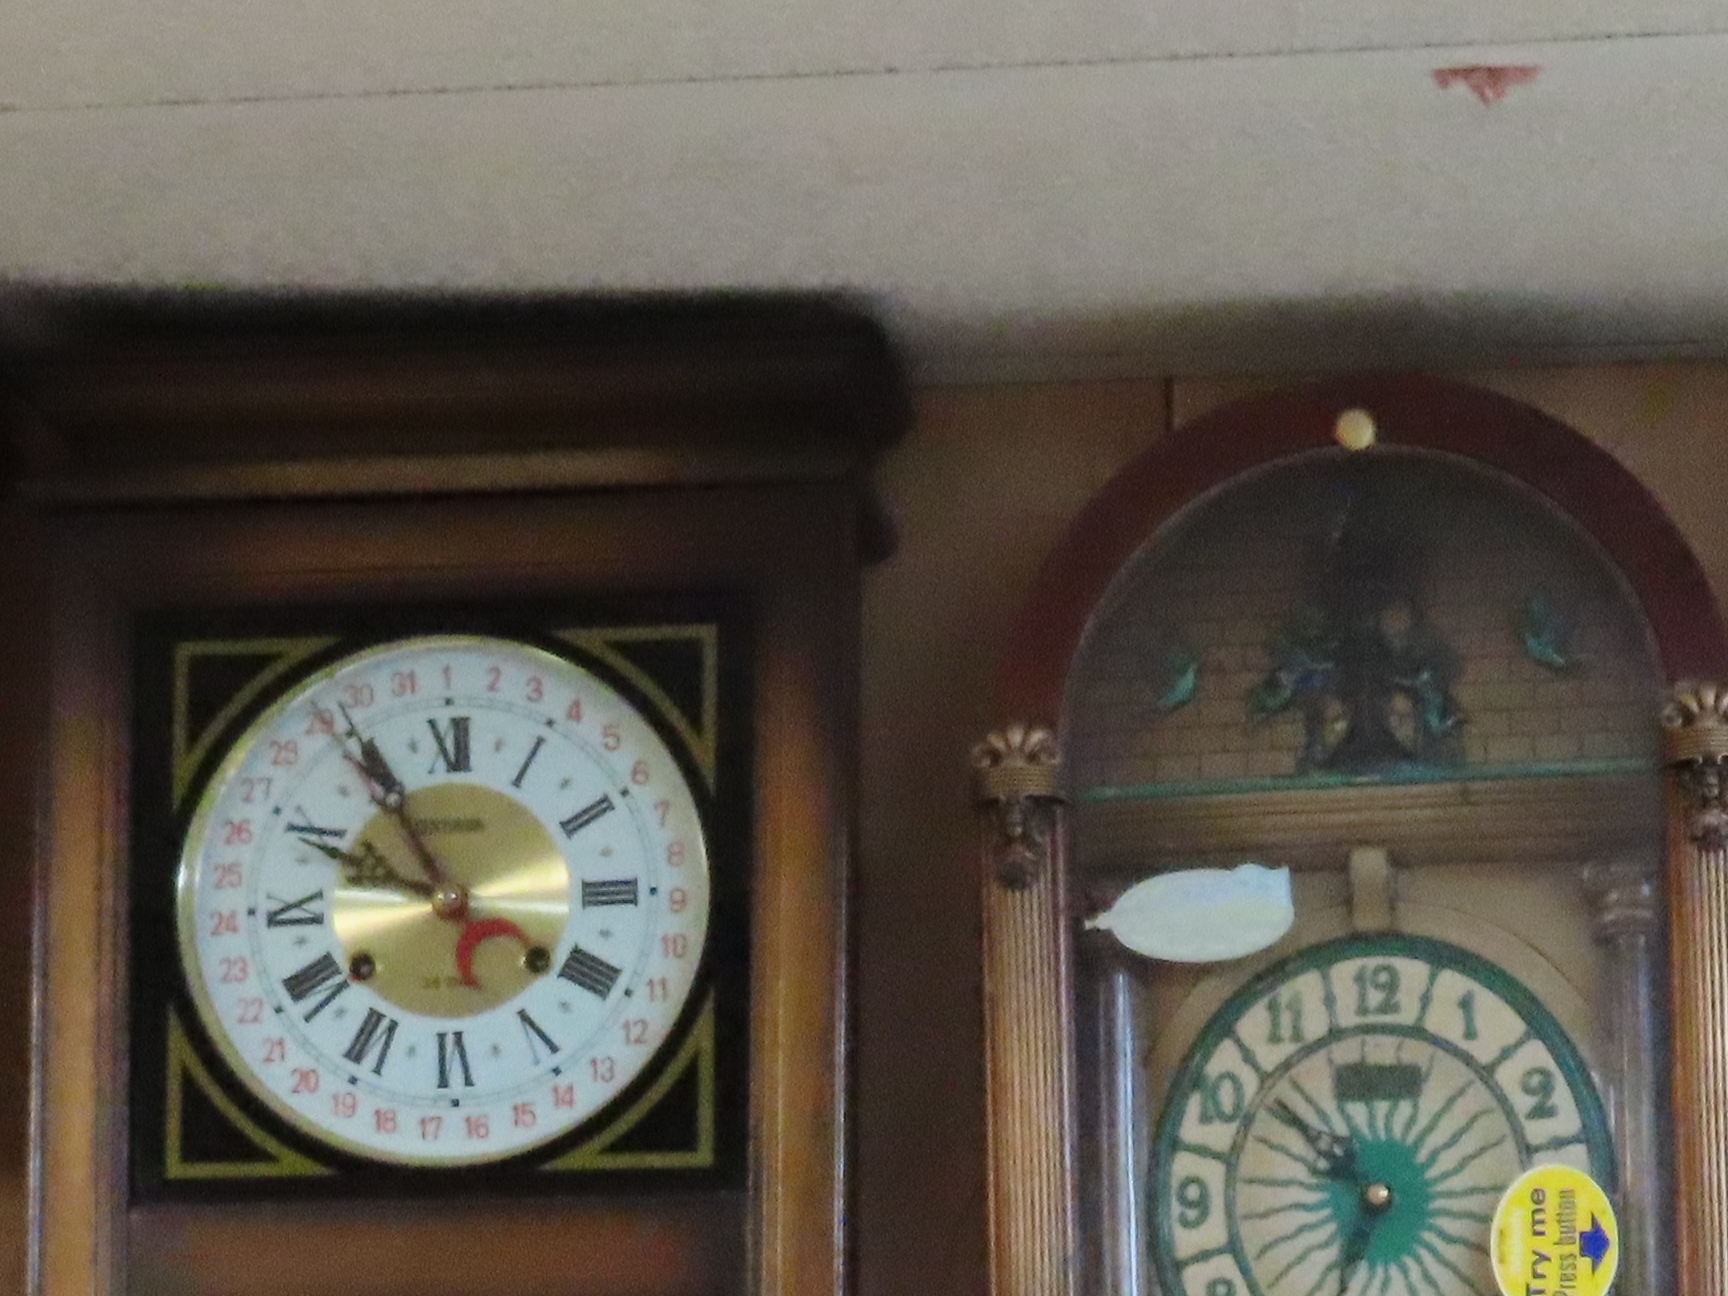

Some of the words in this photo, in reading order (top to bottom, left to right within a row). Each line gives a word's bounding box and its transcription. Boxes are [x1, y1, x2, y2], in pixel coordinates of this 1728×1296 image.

[428, 716, 471, 773] XII
[559, 794, 616, 838] II
[581, 877, 638, 907] III
[1352, 963, 1400, 1018] 12
[1520, 1066, 1560, 1120] 2
[1176, 1176, 1211, 1229] 9
[1530, 1188, 1546, 1236] me
